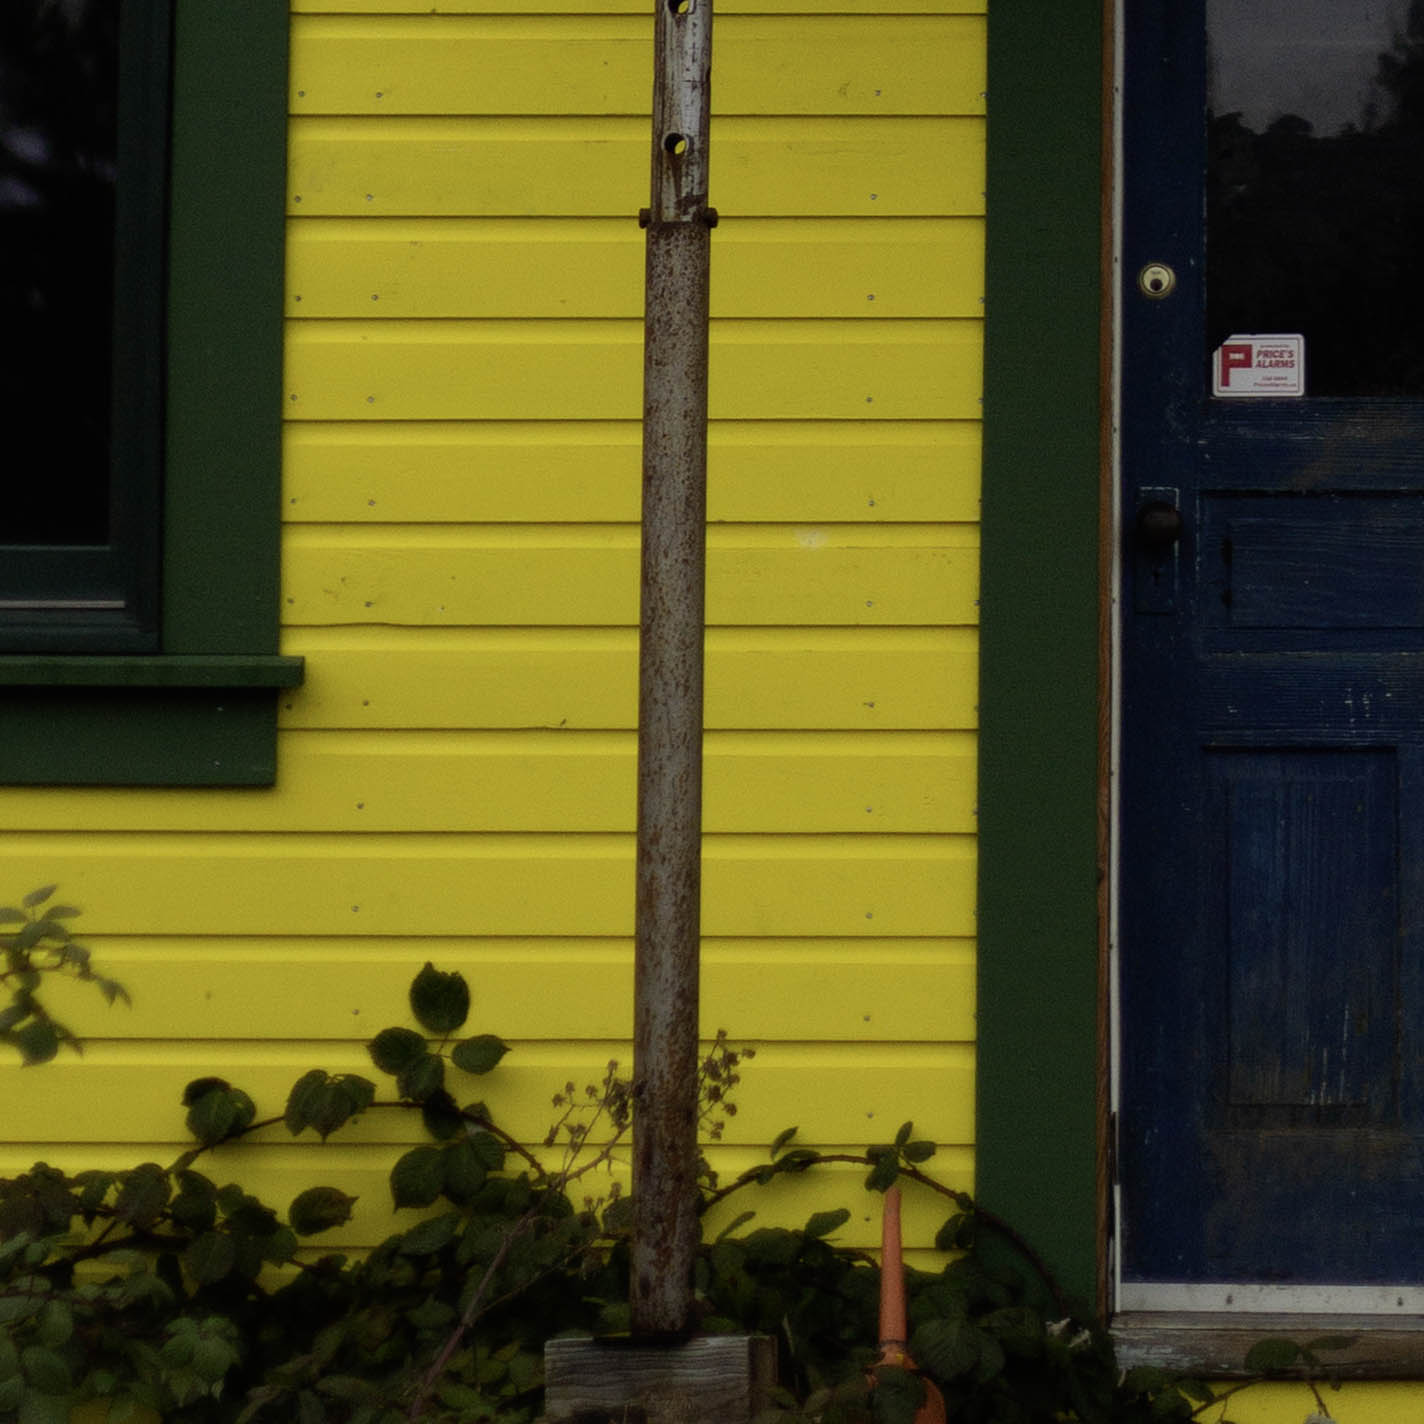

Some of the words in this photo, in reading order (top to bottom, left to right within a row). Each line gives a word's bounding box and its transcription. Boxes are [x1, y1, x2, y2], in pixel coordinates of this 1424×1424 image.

[1256, 349, 1294, 358] PRICE'S
[1221, 344, 1252, 387] P
[1255, 360, 1295, 368] ALARMS
